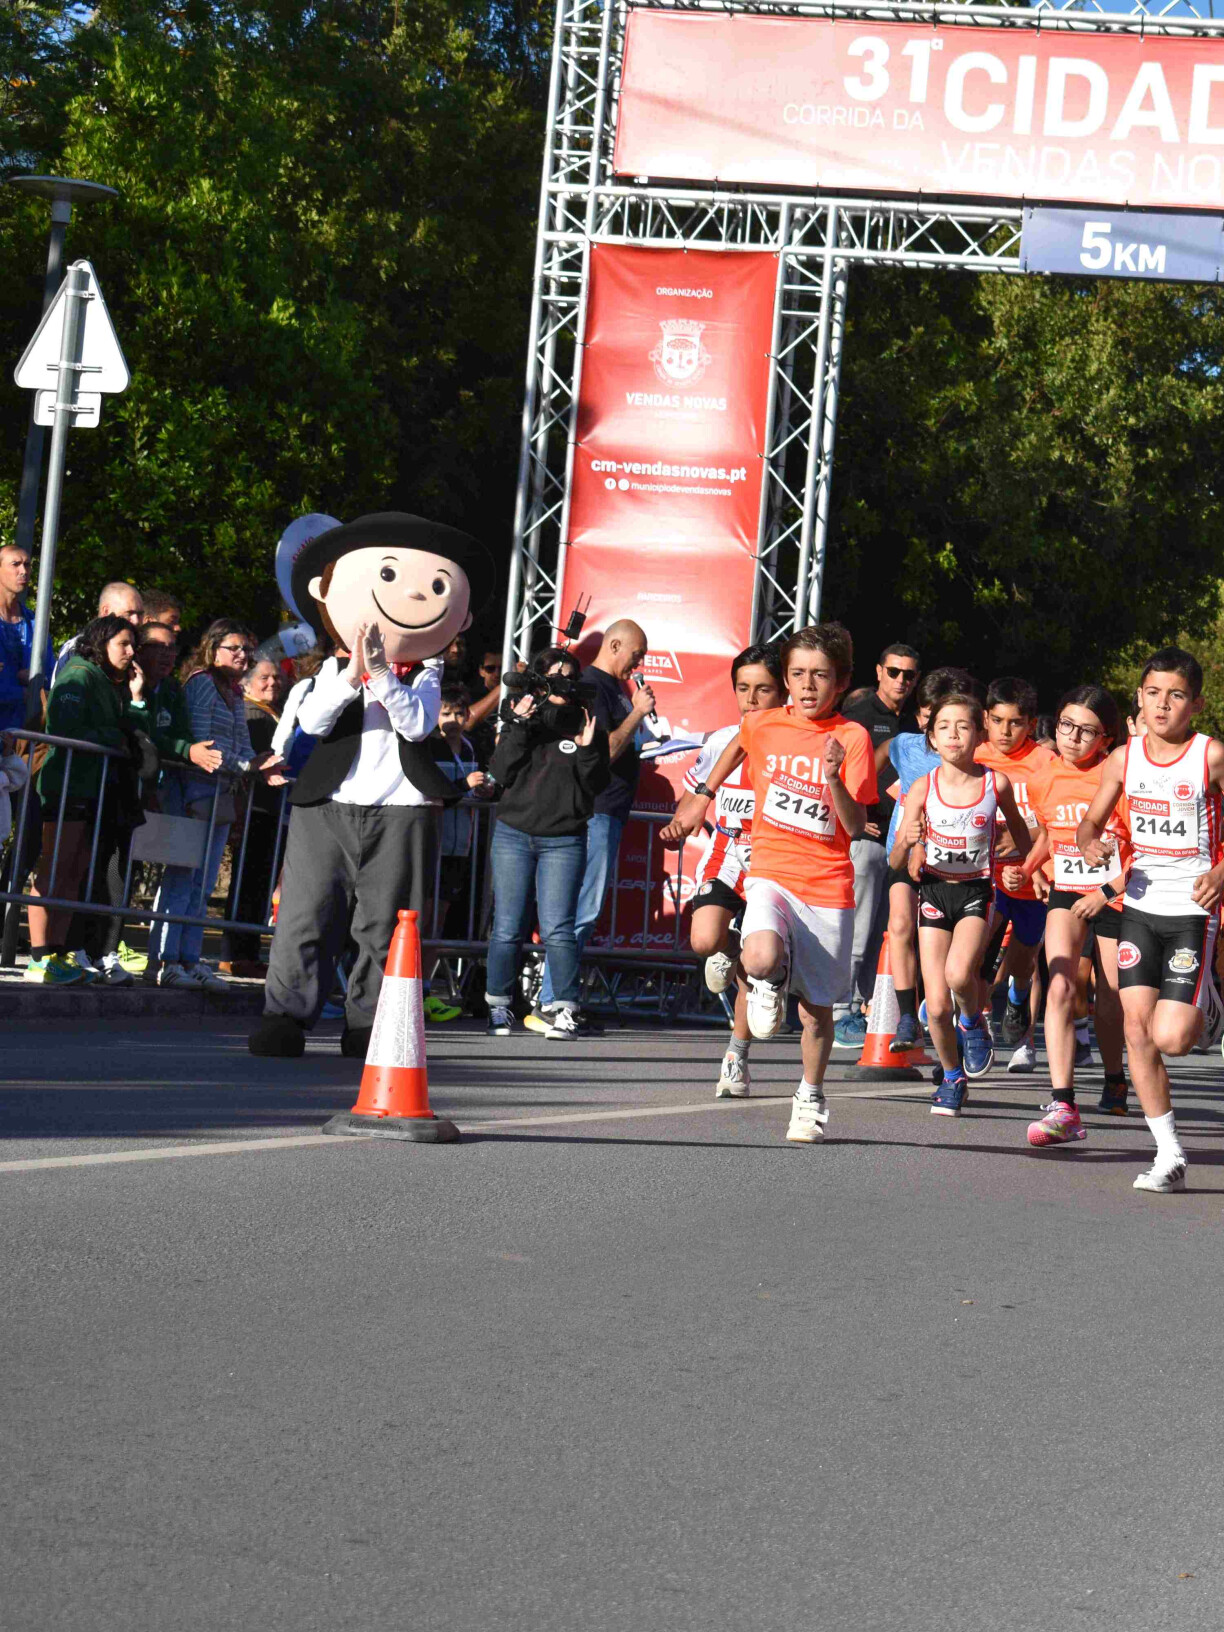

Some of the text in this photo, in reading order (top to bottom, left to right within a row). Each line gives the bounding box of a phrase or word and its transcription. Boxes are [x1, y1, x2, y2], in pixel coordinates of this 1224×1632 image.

[783, 104, 925, 131] CORRIDA DA
[940, 140, 1135, 194] VENDAS
[656, 287, 713, 299] ORGANIZAÇÃO
[626, 392, 727, 410] VENDAS NOVAS
[590, 458, 747, 483] cm-vendasnovas.pt
[643, 655, 673, 668] ELTA
[775, 792, 830, 822] 2142
[1138, 800, 1168, 812] CIDADE
[1136, 816, 1187, 837] 2144
[936, 834, 965, 846] CIDADE
[1063, 844, 1080, 852] CIDA
[934, 847, 980, 864] 2147
